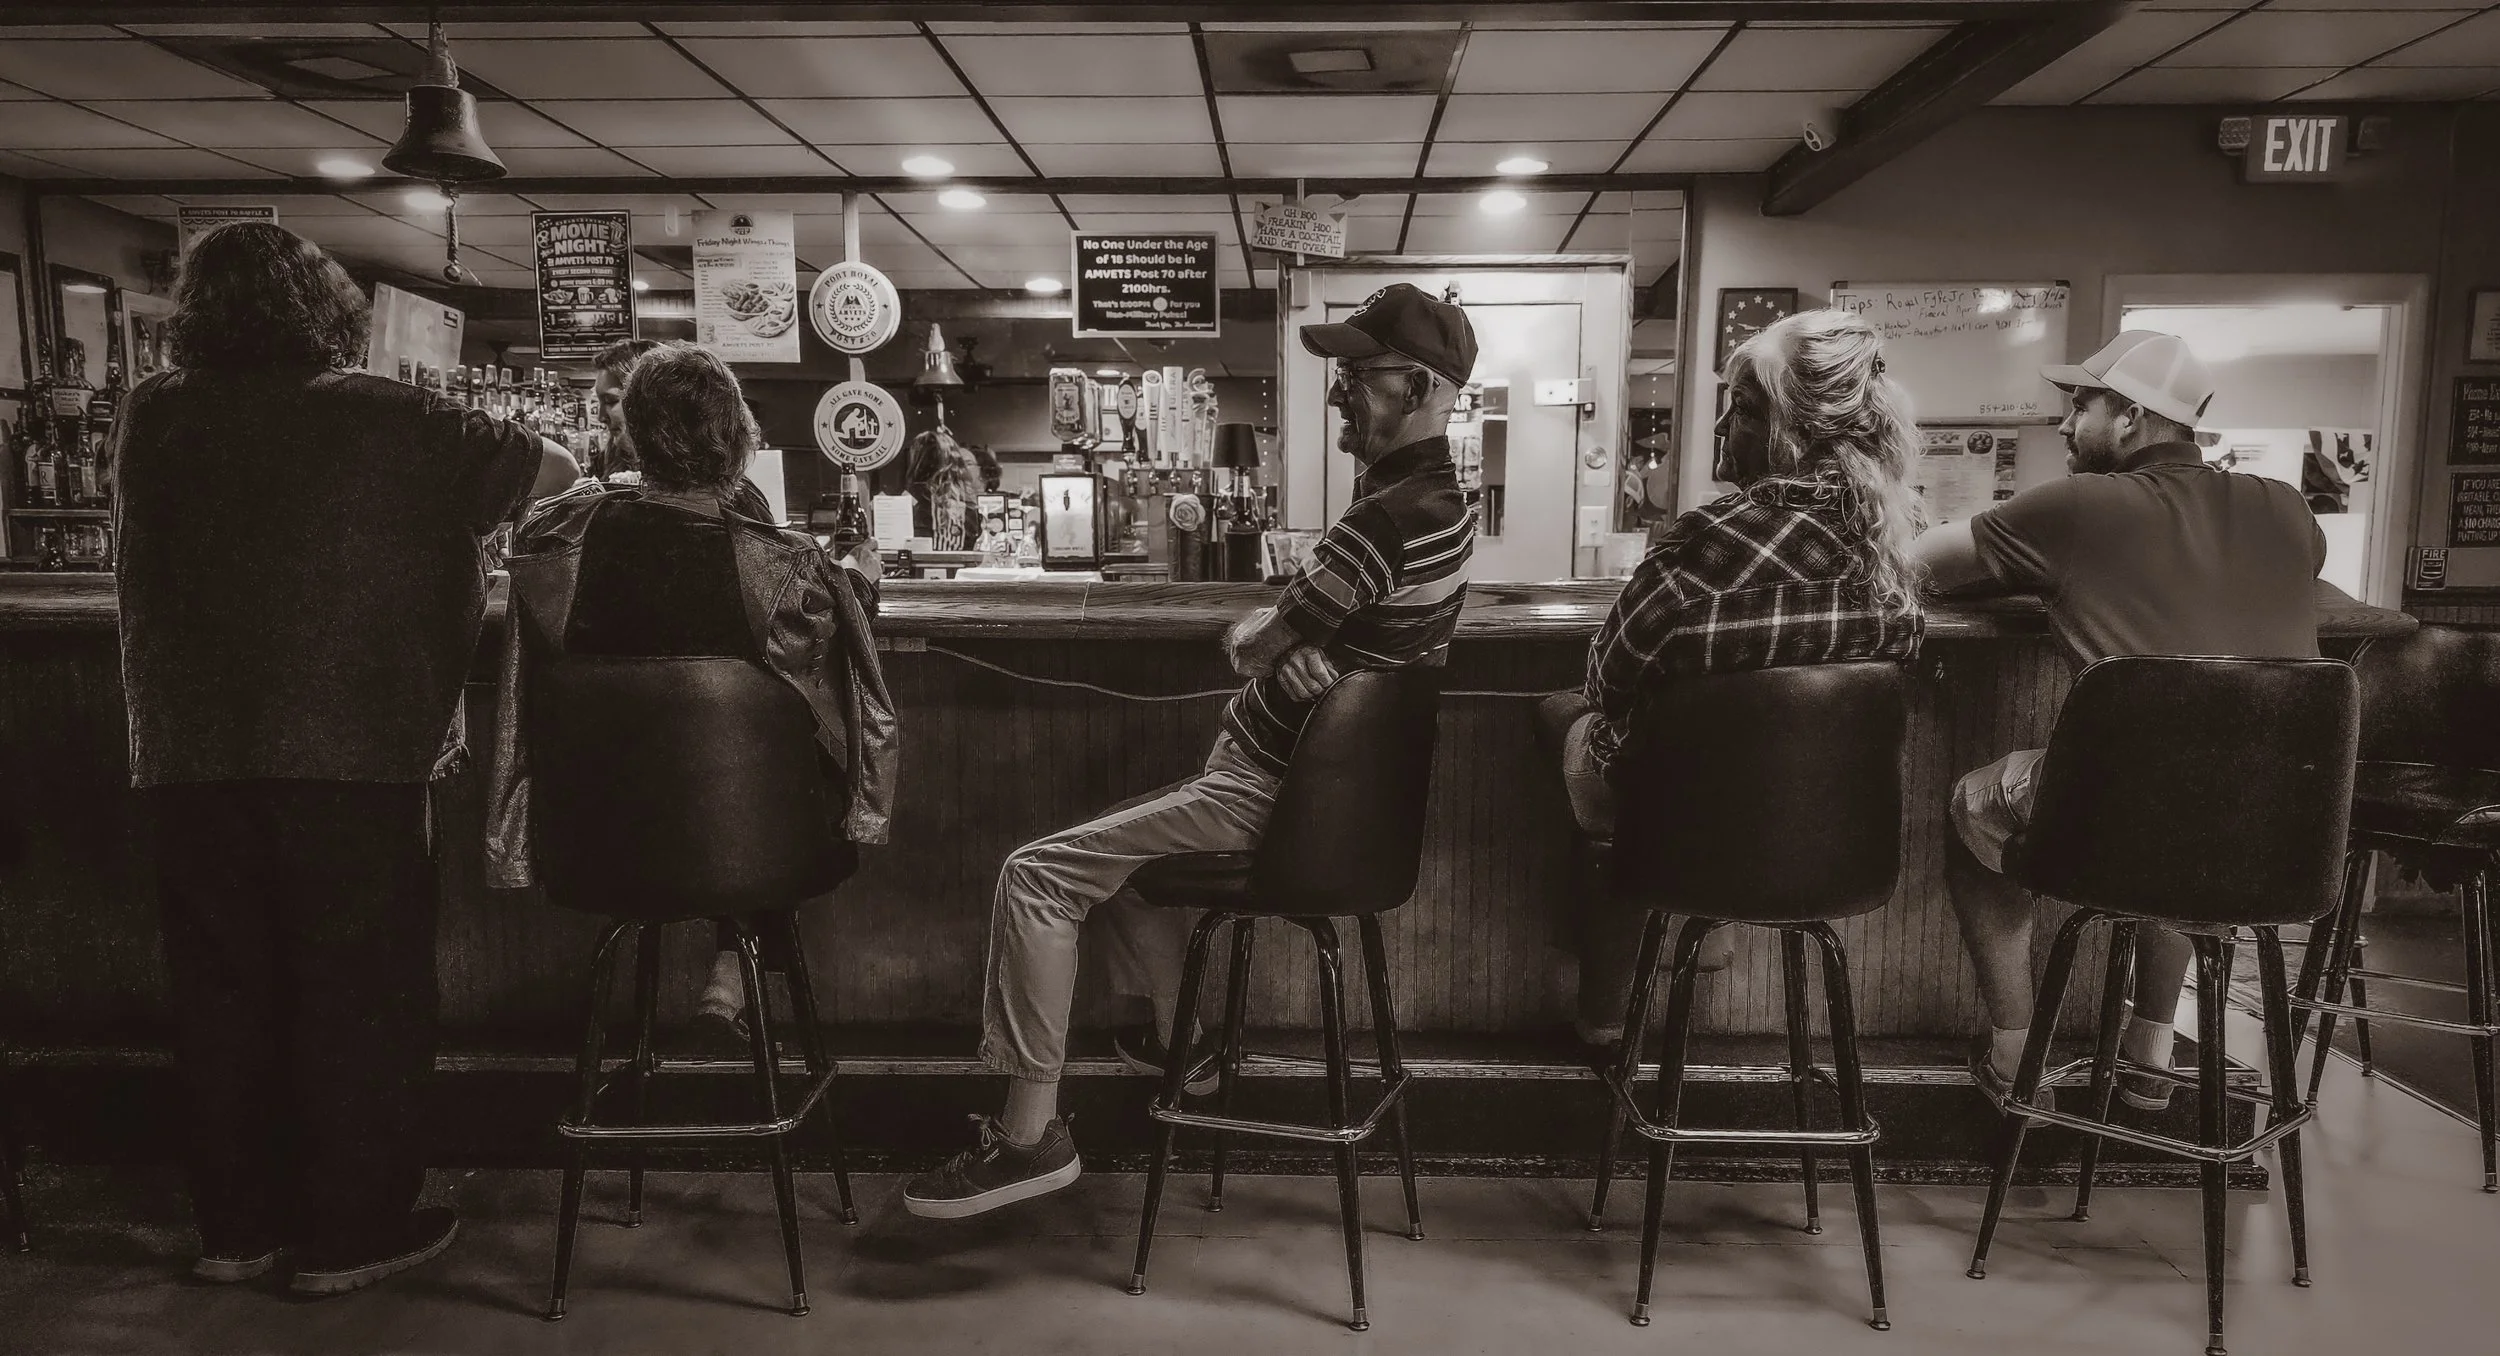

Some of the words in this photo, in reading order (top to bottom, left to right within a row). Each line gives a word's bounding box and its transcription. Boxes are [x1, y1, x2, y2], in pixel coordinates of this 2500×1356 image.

[2264, 119, 2337, 172] EXIT
[1284, 208, 1297, 218] OH
[1300, 210, 1317, 221] BOO
[1268, 217, 1310, 230] FREAKIN'
[550, 223, 610, 242] MOVIE
[1260, 226, 1286, 237] HAVE
[1288, 230, 1296, 238] A
[1299, 231, 1341, 245] COCKTAIL
[554, 239, 607, 255] NIGHT
[696, 239, 721, 247] Friday
[721, 238, 742, 246] Night
[1083, 240, 1099, 249] No
[1101, 240, 1125, 249] One
[1127, 240, 1162, 249] Under
[1164, 240, 1184, 249] the
[1186, 240, 1208, 251] Age
[1257, 236, 1278, 246] AND
[1281, 239, 1300, 250] GET
[1303, 242, 1327, 253] OVER
[1330, 246, 1341, 255] IT
[555, 256, 585, 265] AMVETS
[585, 256, 604, 265] POST
[605, 256, 614, 265] 70
[1095, 254, 1110, 264] of
[1110, 254, 1124, 264] 18
[1125, 254, 1166, 264] Should
[1168, 254, 1182, 264] be
[1184, 254, 1196, 264] in
[824, 270, 847, 288] PORT
[850, 270, 879, 287] ROYAL
[1084, 269, 1132, 279] AMVETS
[1133, 269, 1159, 279] Post
[1161, 269, 1176, 279] 70
[1177, 269, 1207, 279] after
[1121, 283, 1171, 293] 2100hrs.
[1092, 300, 1119, 308] That's
[1169, 300, 1183, 308] for
[1184, 301, 1200, 309] you
[829, 329, 856, 345] POST
[859, 330, 877, 344] #70
[829, 395, 842, 408] ALL
[842, 389, 862, 397] GAVE
[864, 391, 884, 406] SOME
[831, 445, 850, 461] SOME
[852, 455, 874, 464] GAVE
[875, 445, 888, 457] ALL
[2462, 480, 2471, 491] IF
[2471, 480, 2487, 490] YOU
[2464, 517, 2477, 529] $10
[2477, 516, 2500, 529] CHARG
[2457, 530, 2487, 542] PUTTING
[2488, 530, 2498, 541] UP
[2422, 549, 2447, 558] FIRE
